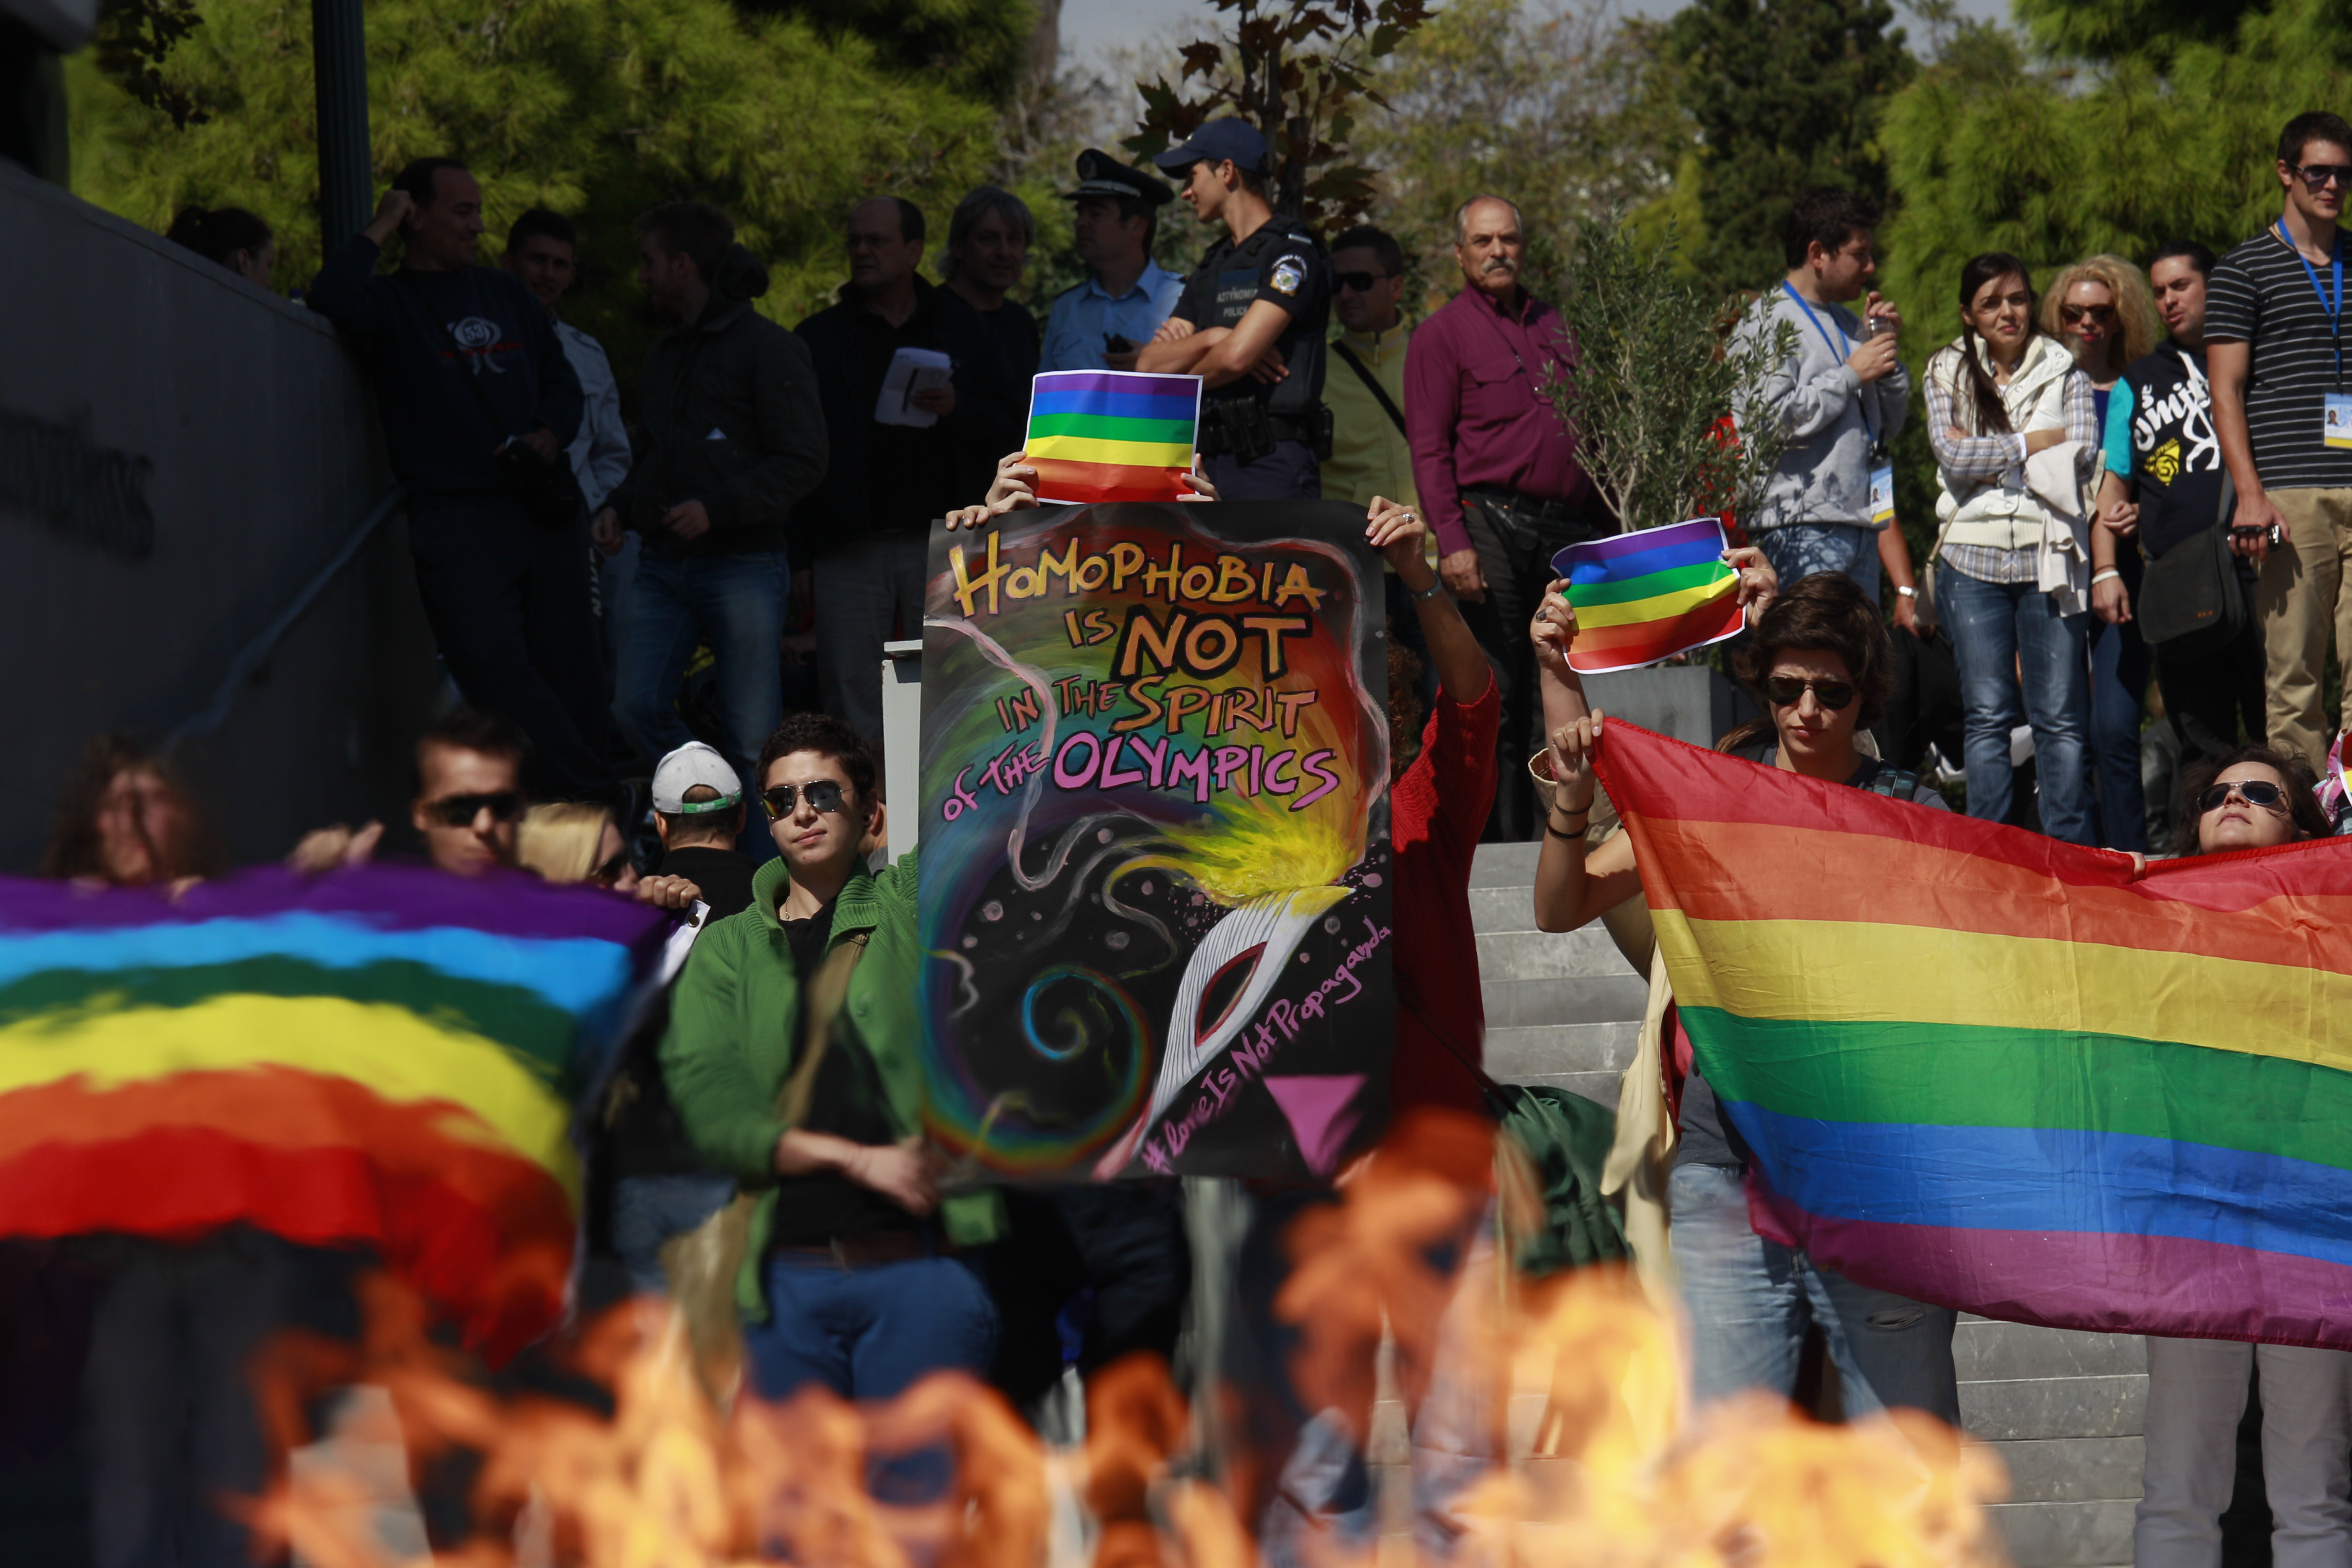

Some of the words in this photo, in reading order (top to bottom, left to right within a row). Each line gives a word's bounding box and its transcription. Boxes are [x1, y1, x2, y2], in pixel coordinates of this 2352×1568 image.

[1064, 607, 1117, 647] IS
[1116, 609, 1310, 679] NOT
[996, 687, 1040, 732] IN
[1052, 675, 1123, 719] THE
[1109, 674, 1318, 738] SPIRIT
[1052, 732, 1340, 811] OLYMPICS
